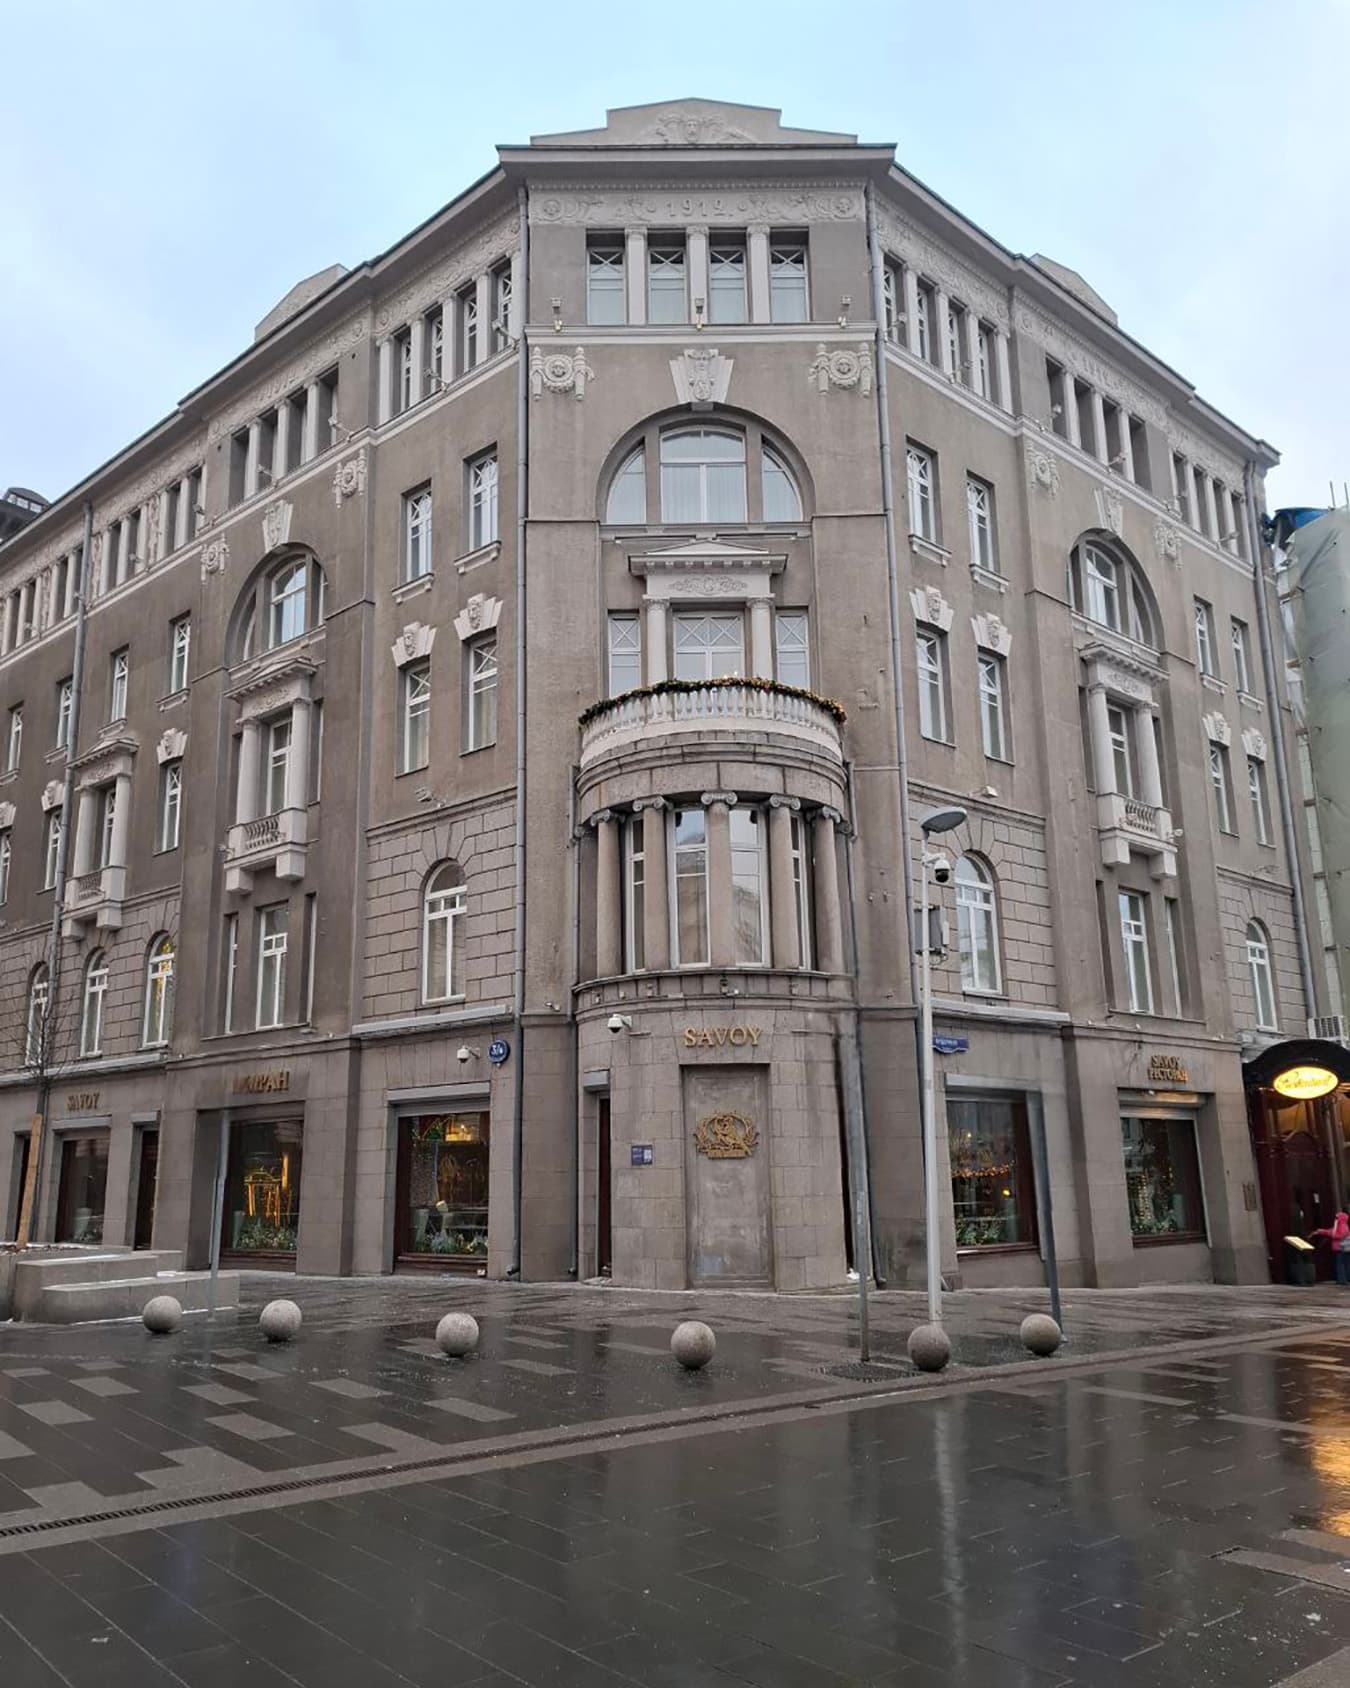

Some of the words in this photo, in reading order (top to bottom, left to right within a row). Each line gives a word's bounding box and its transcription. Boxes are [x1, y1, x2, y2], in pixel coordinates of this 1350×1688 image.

[684, 1026, 762, 1047] SAVOY
[1150, 1055, 1180, 1070] SAVOY
[65, 1092, 100, 1111] SAVOY
